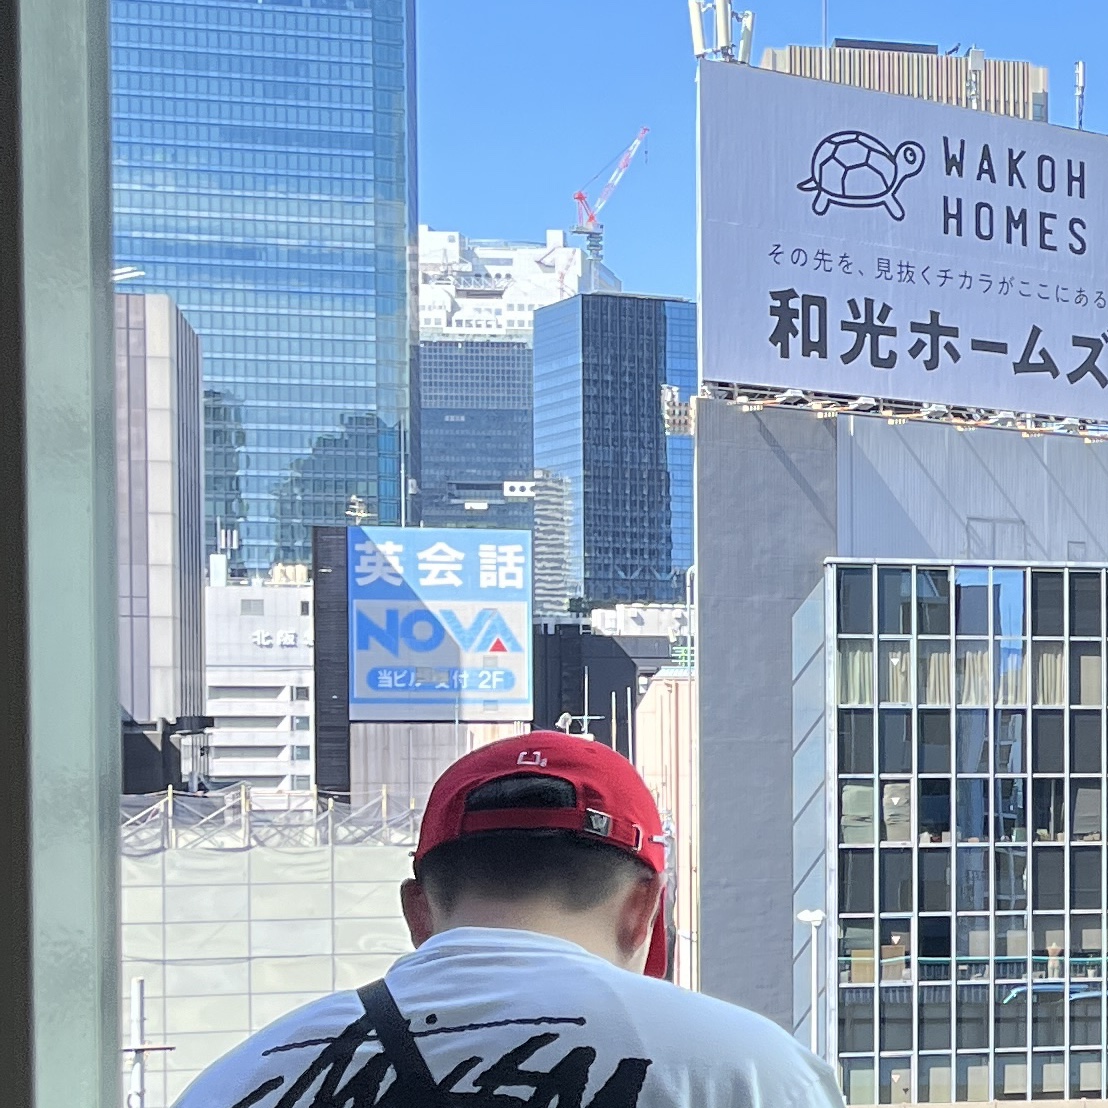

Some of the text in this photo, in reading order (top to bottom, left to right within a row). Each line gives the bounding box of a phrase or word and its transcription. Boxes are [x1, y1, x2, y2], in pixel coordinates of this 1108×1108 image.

[942, 135, 1087, 199] WAKOH
[943, 195, 1088, 256] HOMES
[354, 541, 525, 589] 英会話
[356, 608, 524, 658] NOVA
